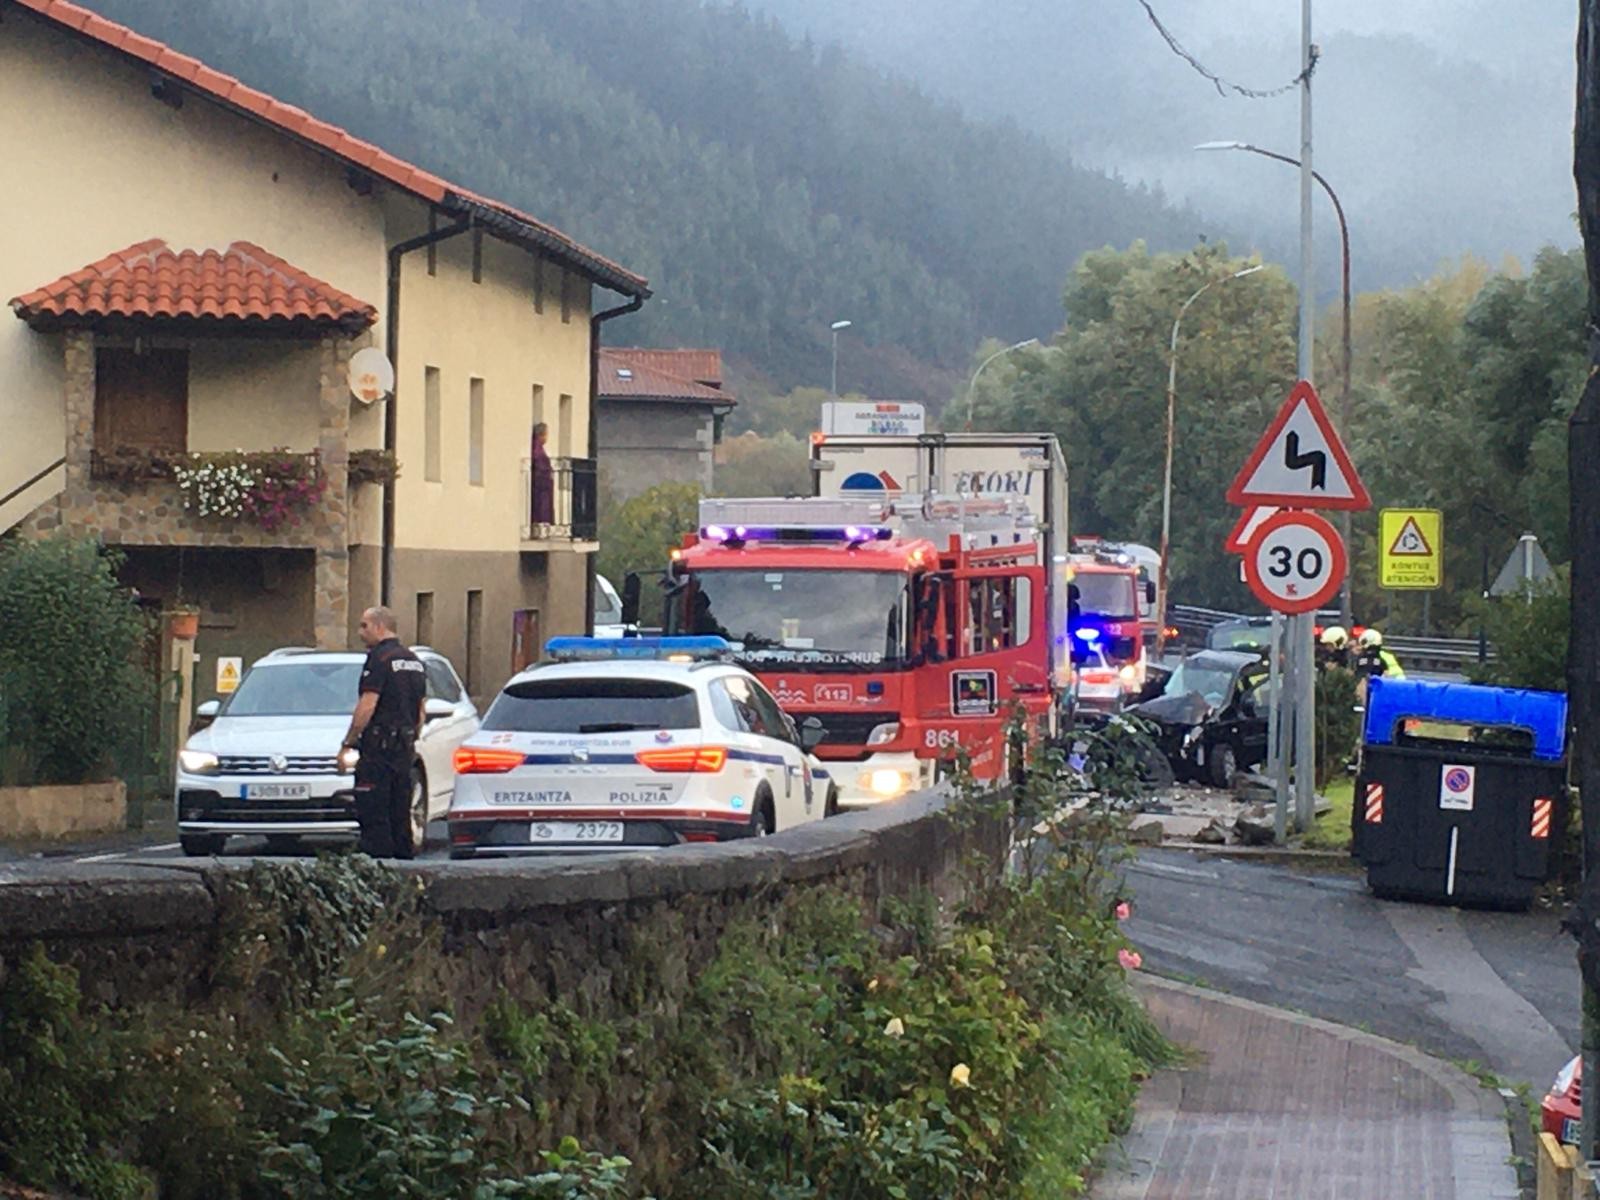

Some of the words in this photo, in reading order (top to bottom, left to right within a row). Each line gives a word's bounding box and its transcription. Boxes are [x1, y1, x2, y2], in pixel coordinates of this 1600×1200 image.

[1268, 545, 1323, 579] 30
[823, 689, 849, 700] 112
[925, 729, 960, 748] 861
[494, 790, 573, 802] ERTZAINTZA
[609, 791, 669, 802] POLIZIA
[575, 822, 620, 839] 2372
